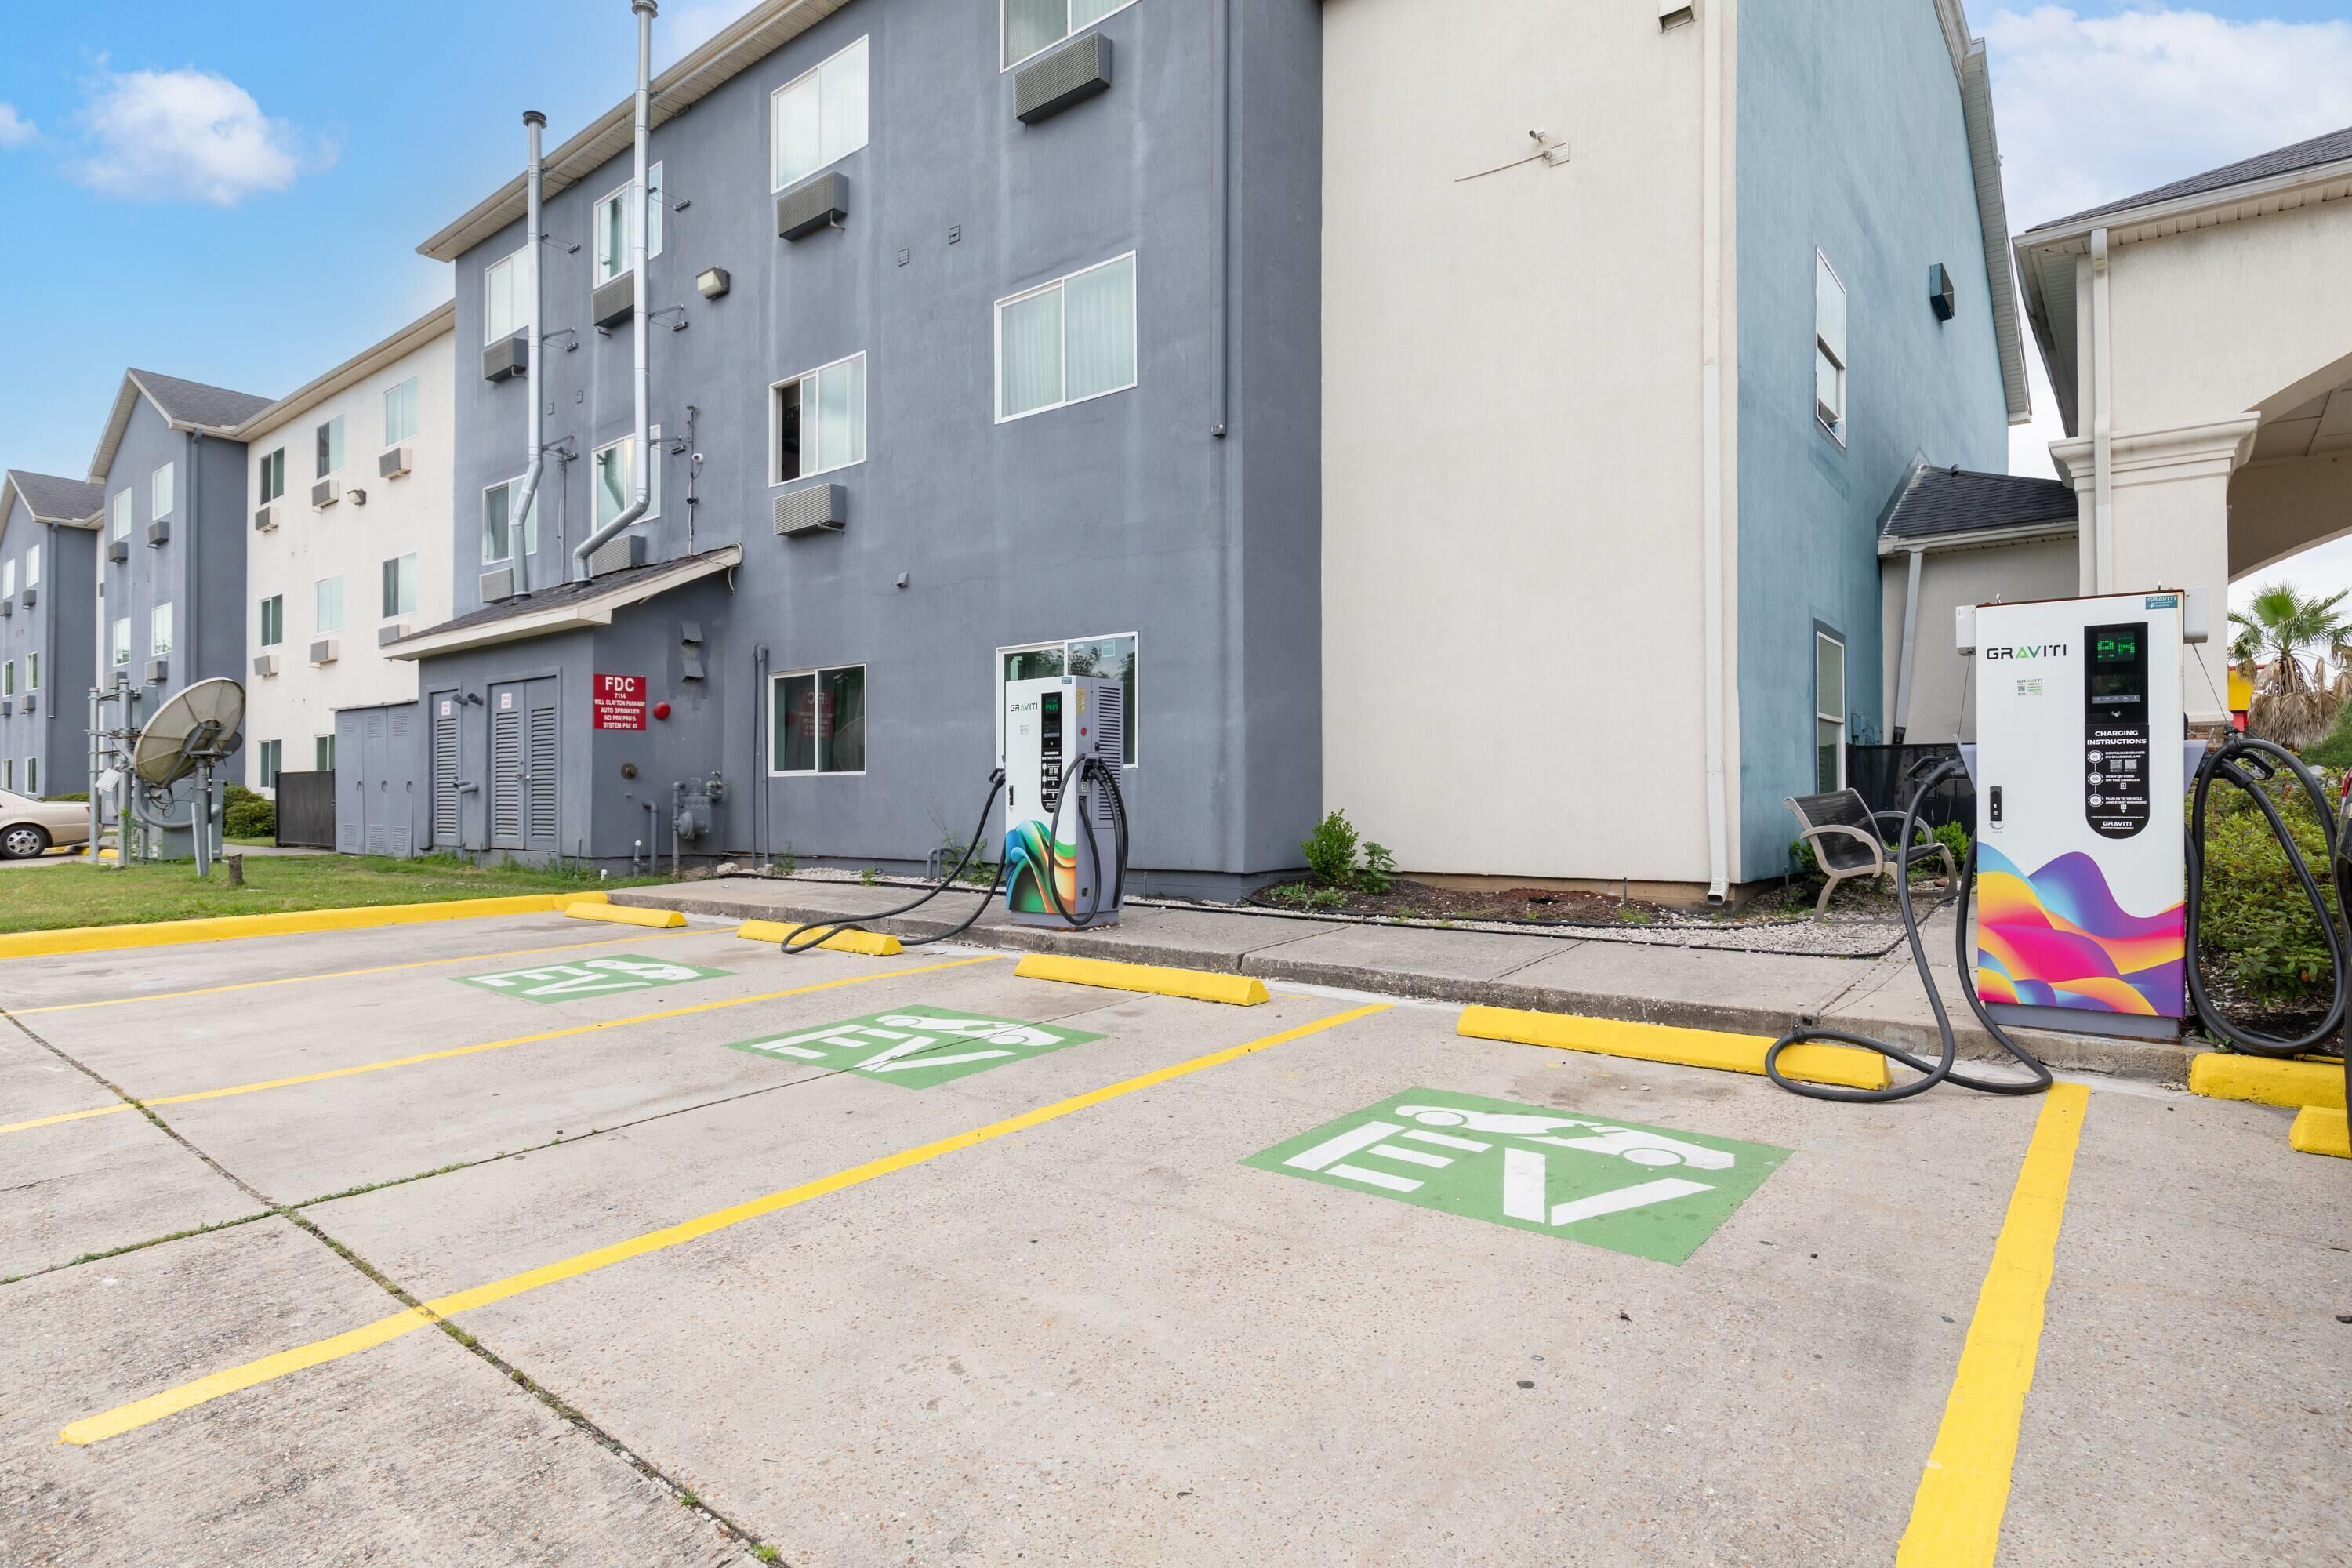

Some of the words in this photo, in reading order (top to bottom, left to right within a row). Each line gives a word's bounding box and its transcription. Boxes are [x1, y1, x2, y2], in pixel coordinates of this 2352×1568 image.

[1987, 644, 2067, 660] GRAVITI
[605, 677, 635, 692] FDC
[1011, 702, 1038, 711] GRAVITI
[467, 965, 652, 996] EV
[750, 1024, 1018, 1073] EV
[1281, 1121, 1717, 1227] EV
